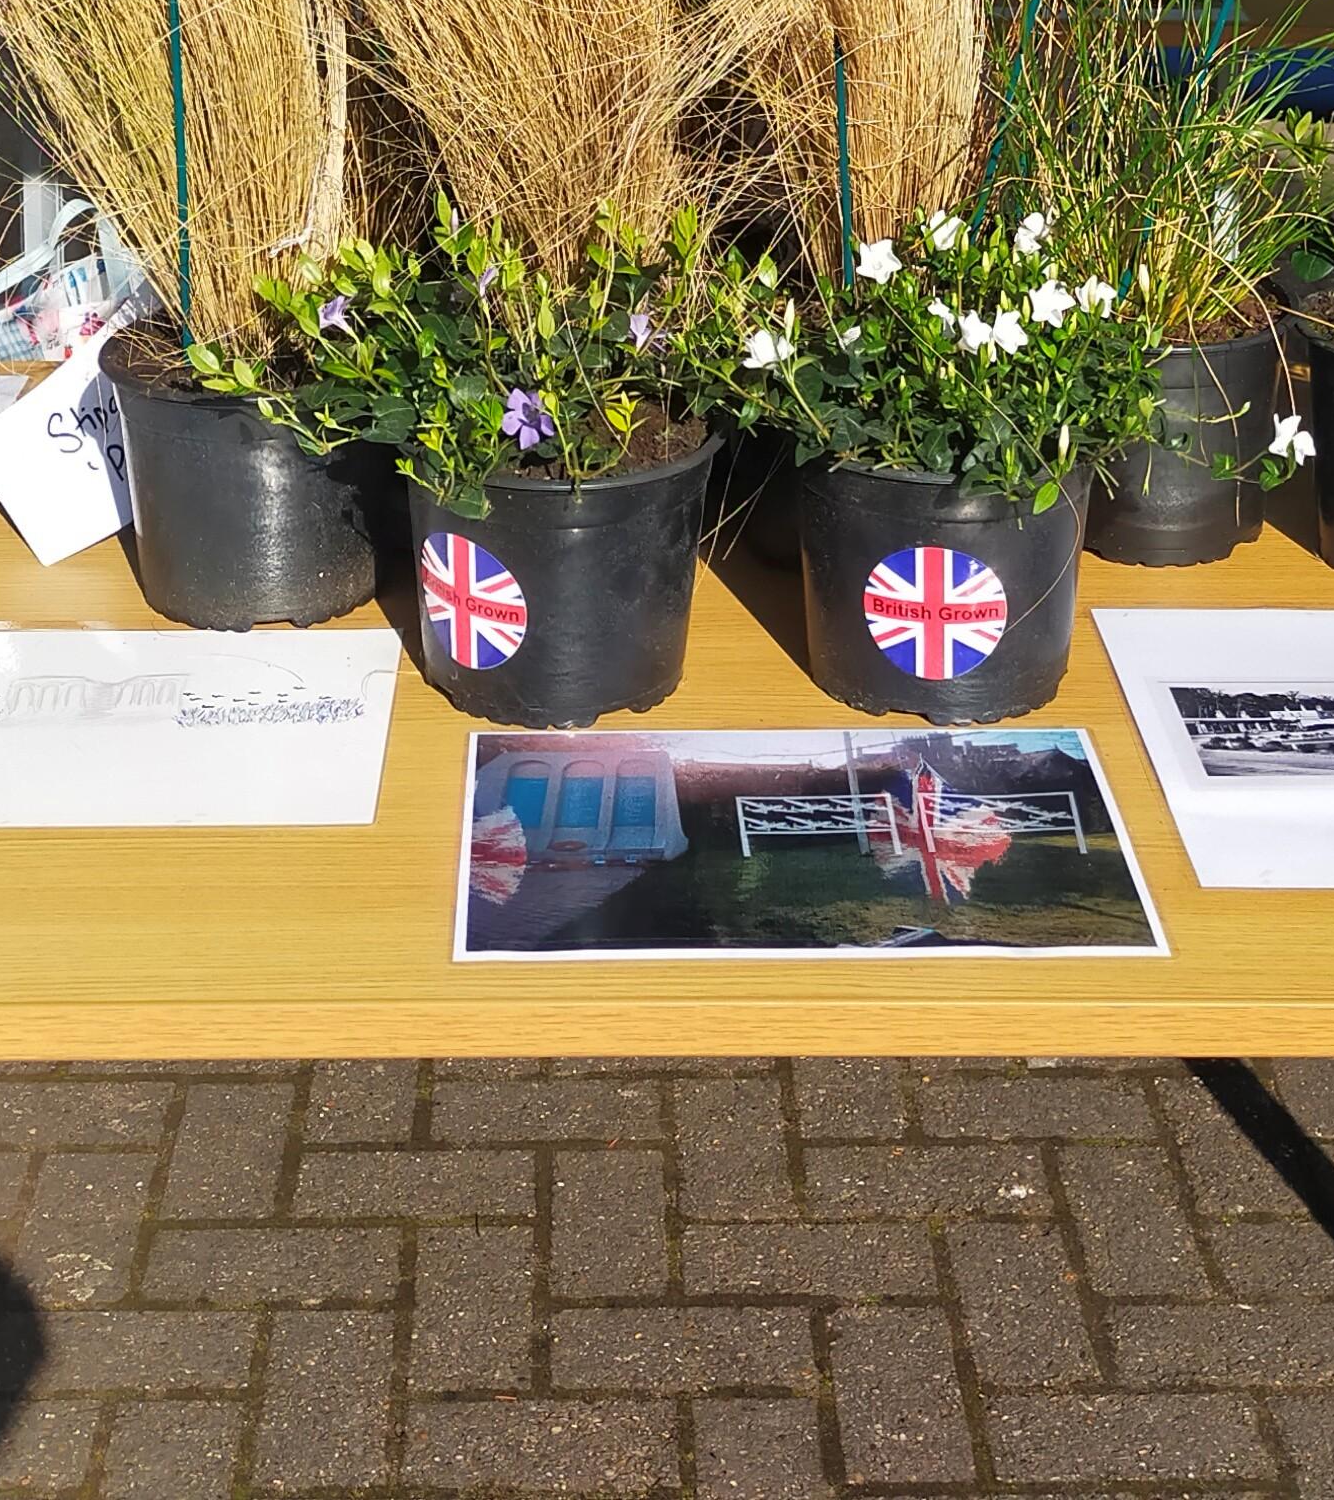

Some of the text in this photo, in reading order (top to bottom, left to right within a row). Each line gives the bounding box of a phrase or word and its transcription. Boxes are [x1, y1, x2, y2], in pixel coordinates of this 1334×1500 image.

[466, 595, 520, 623] Grown
[873, 597, 999, 622] British Grown
